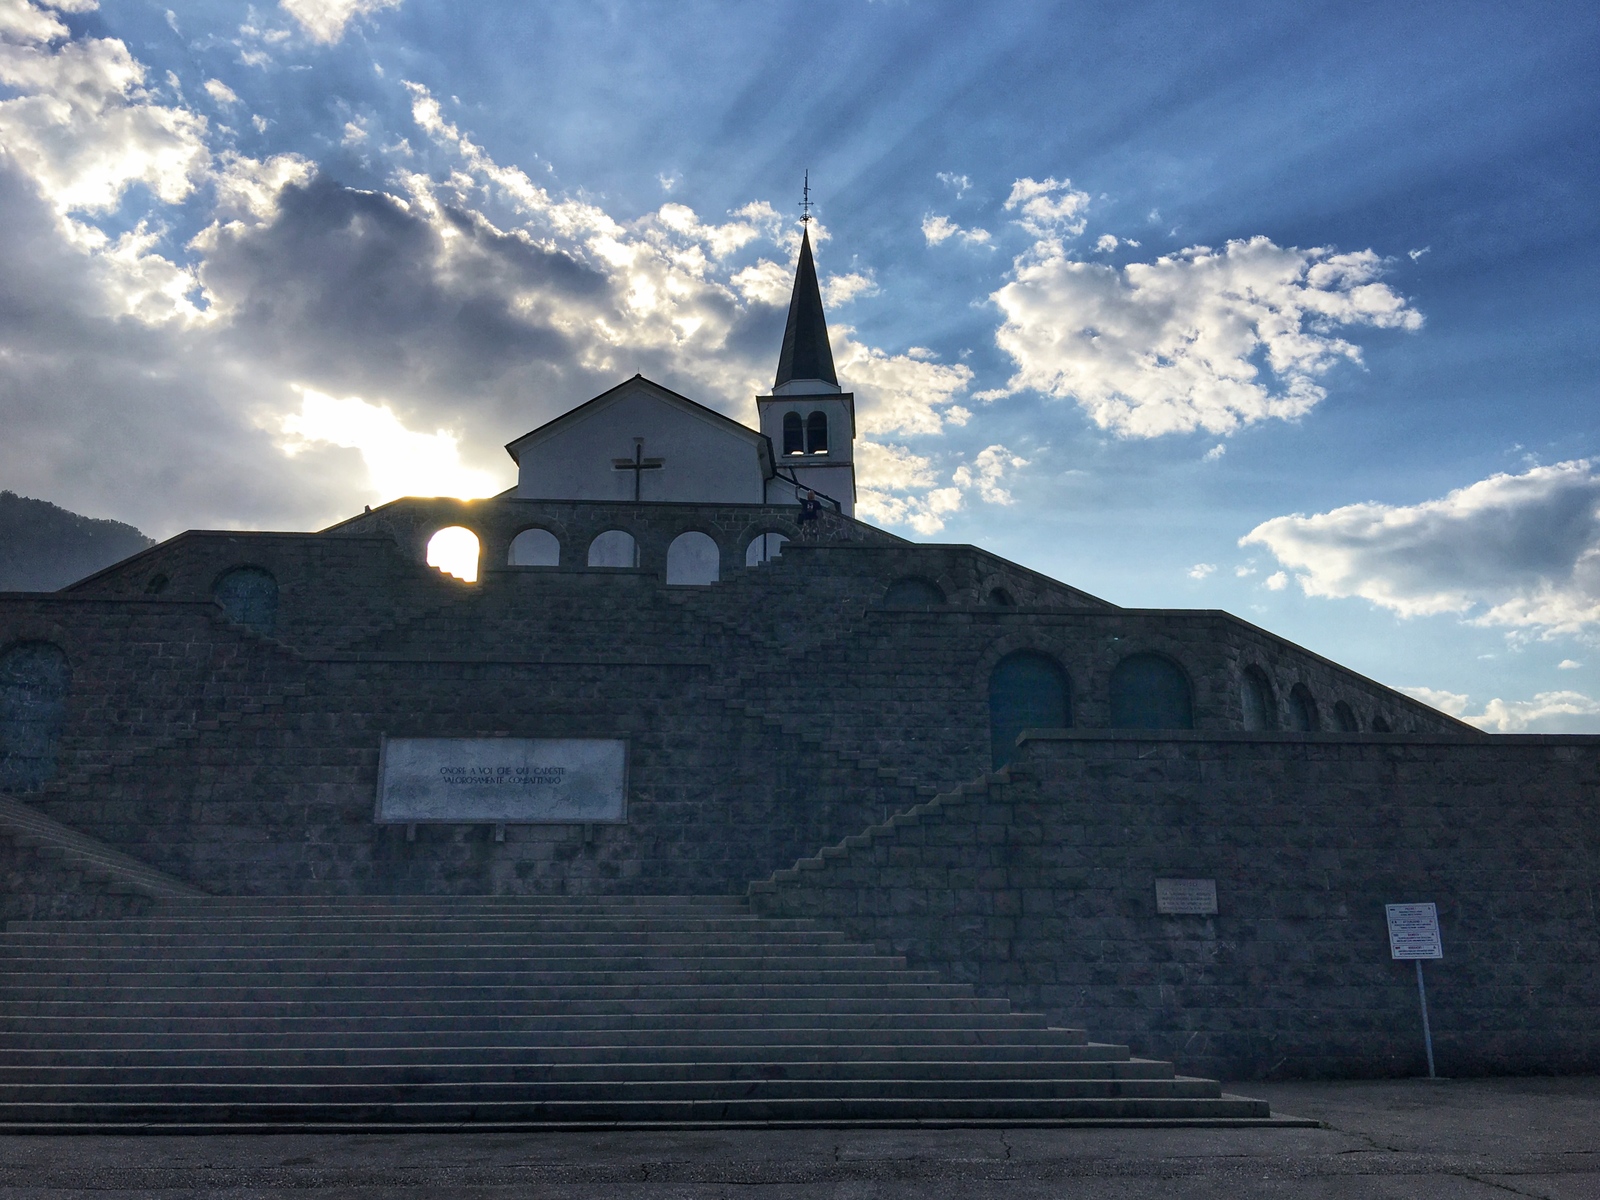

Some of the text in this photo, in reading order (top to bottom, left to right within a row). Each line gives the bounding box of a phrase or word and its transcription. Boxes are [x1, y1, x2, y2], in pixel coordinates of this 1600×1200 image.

[440, 766, 565, 775] ONORE A VOI CHE QUI CADESTE
[443, 776, 562, 784] VALOROSAMENTE COMBATTENDO
